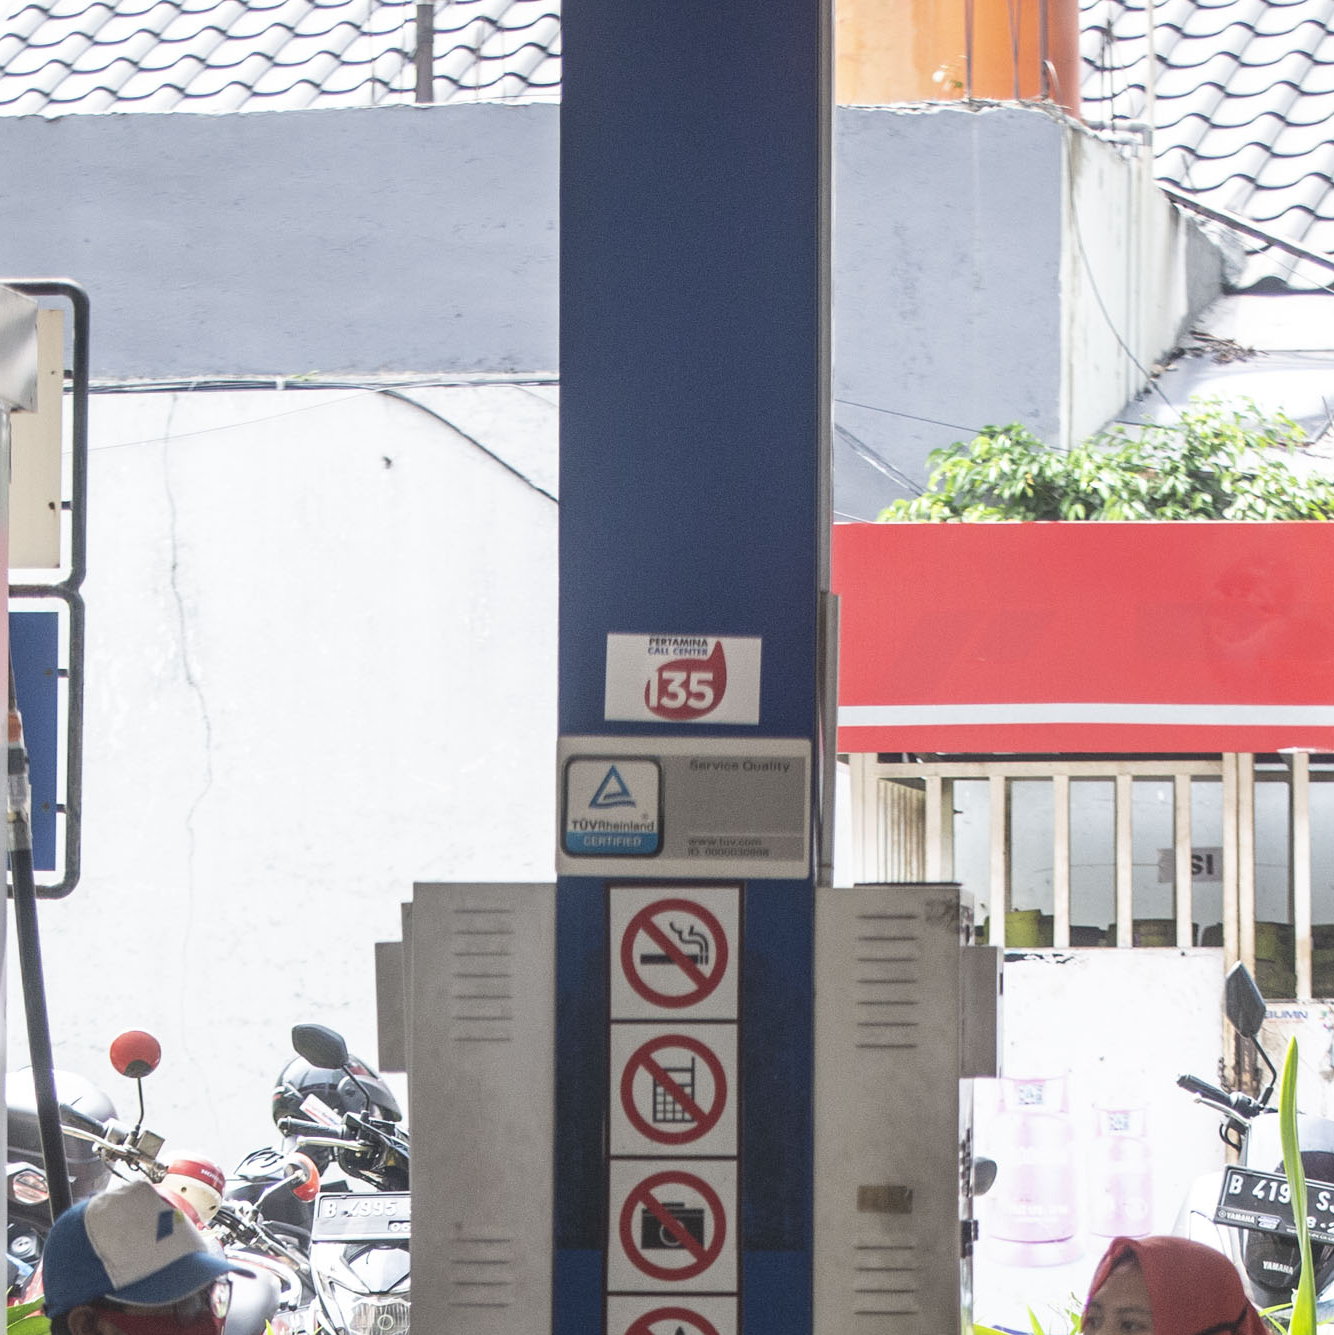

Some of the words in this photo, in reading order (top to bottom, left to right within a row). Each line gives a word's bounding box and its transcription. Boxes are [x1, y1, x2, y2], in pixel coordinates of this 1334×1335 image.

[648, 637, 709, 648] PERTAMINA
[647, 647, 669, 656] CALL
[673, 648, 708, 657] CENTER
[648, 671, 715, 710] 135
[689, 759, 739, 773] Service
[584, 834, 642, 848] CERTIFIED
[1229, 1175, 1244, 1195] B
[1252, 1180, 1295, 1205] 419
[325, 1201, 337, 1218] B
[1263, 1260, 1294, 1275] YAMAHA
